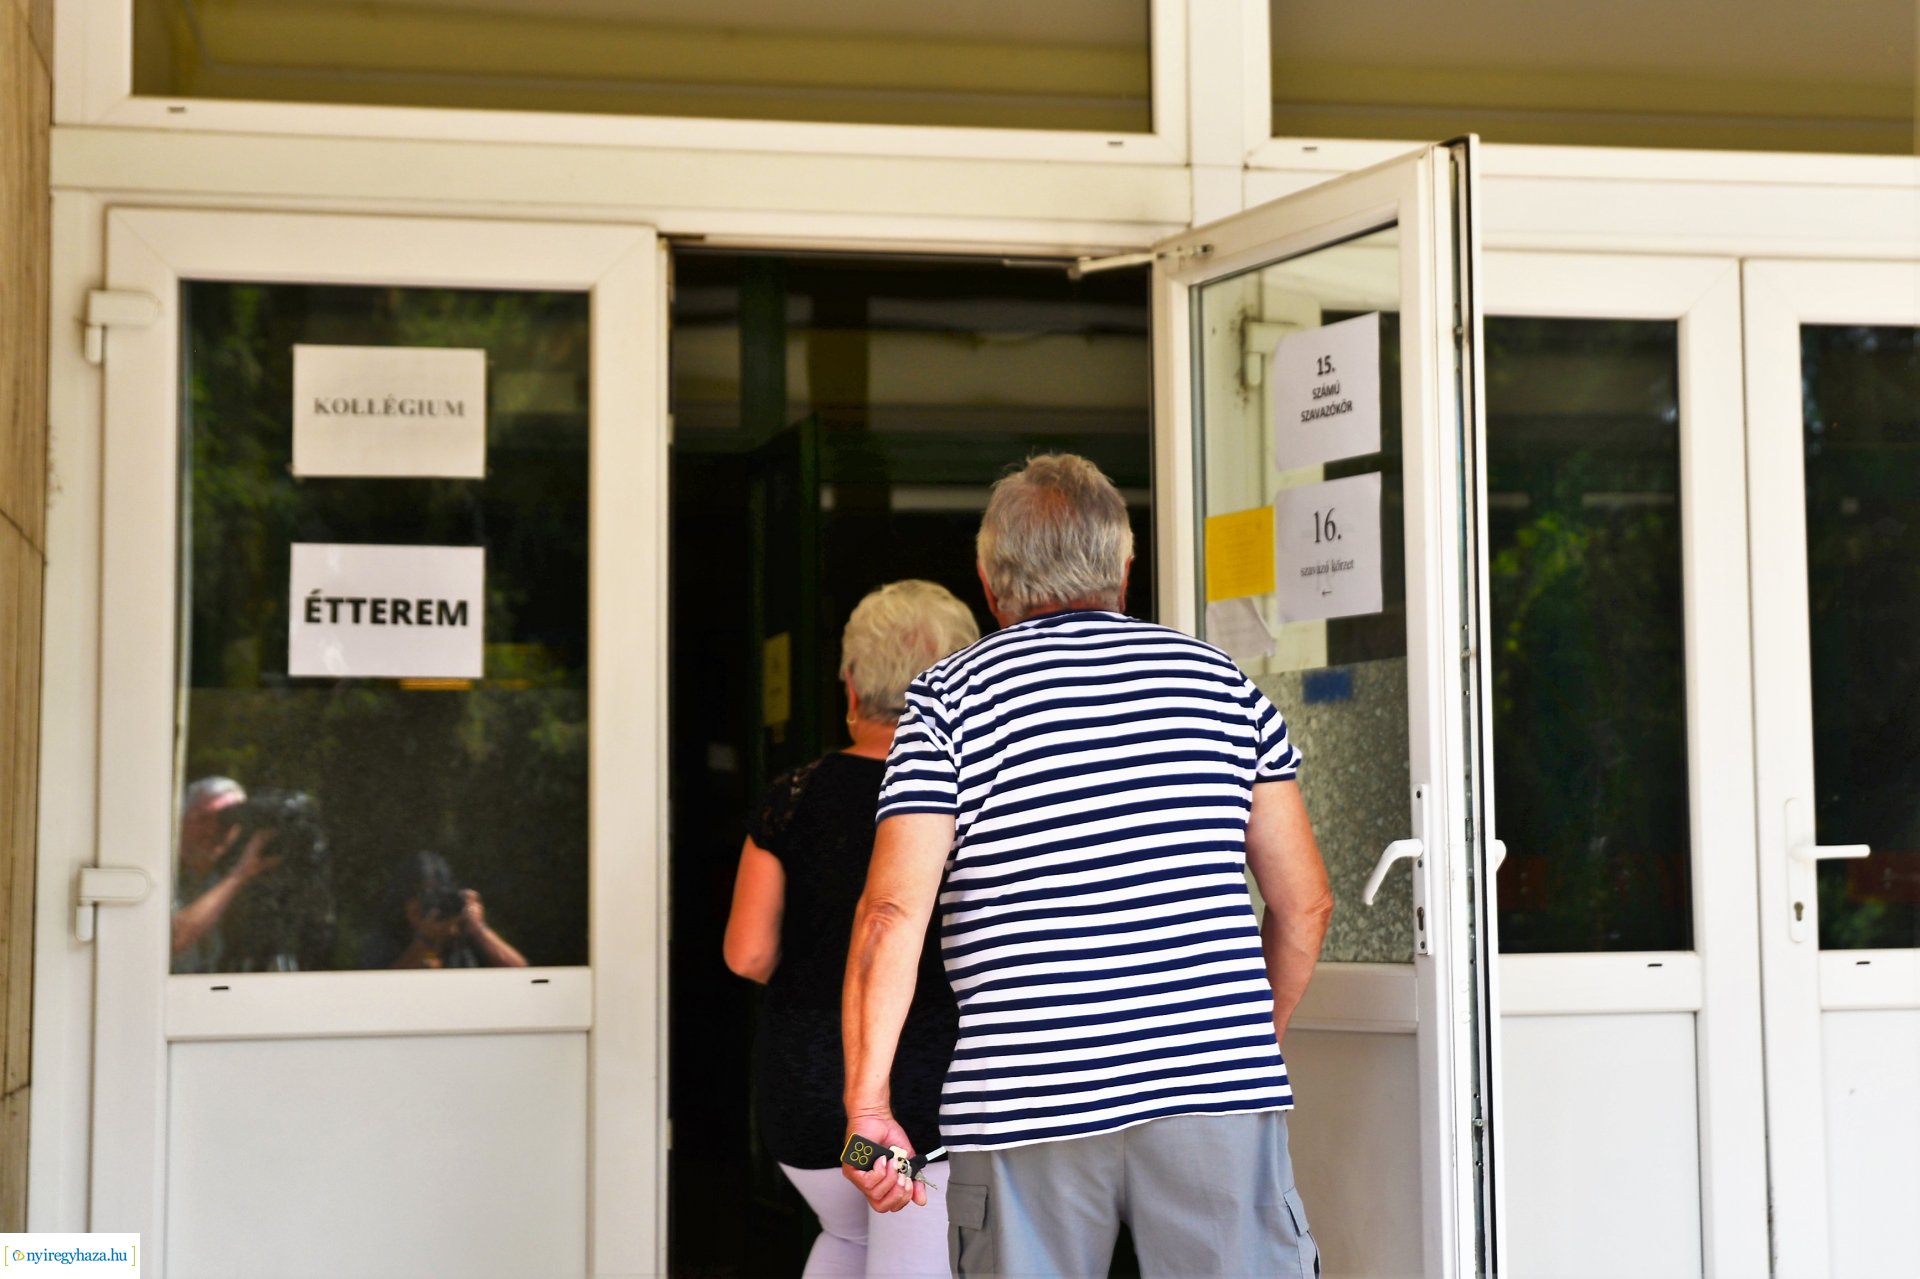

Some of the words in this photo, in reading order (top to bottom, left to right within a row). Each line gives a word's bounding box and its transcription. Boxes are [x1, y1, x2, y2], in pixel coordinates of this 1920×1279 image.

[1317, 354, 1336, 376] 15.
[1312, 380, 1340, 400] SZÁMÚ
[313, 394, 466, 417] KOLLÉGIUM
[1300, 399, 1353, 423] SZAVAZÓKÖR
[1313, 507, 1342, 543] 16.
[304, 588, 469, 627] ÉTTEREM
